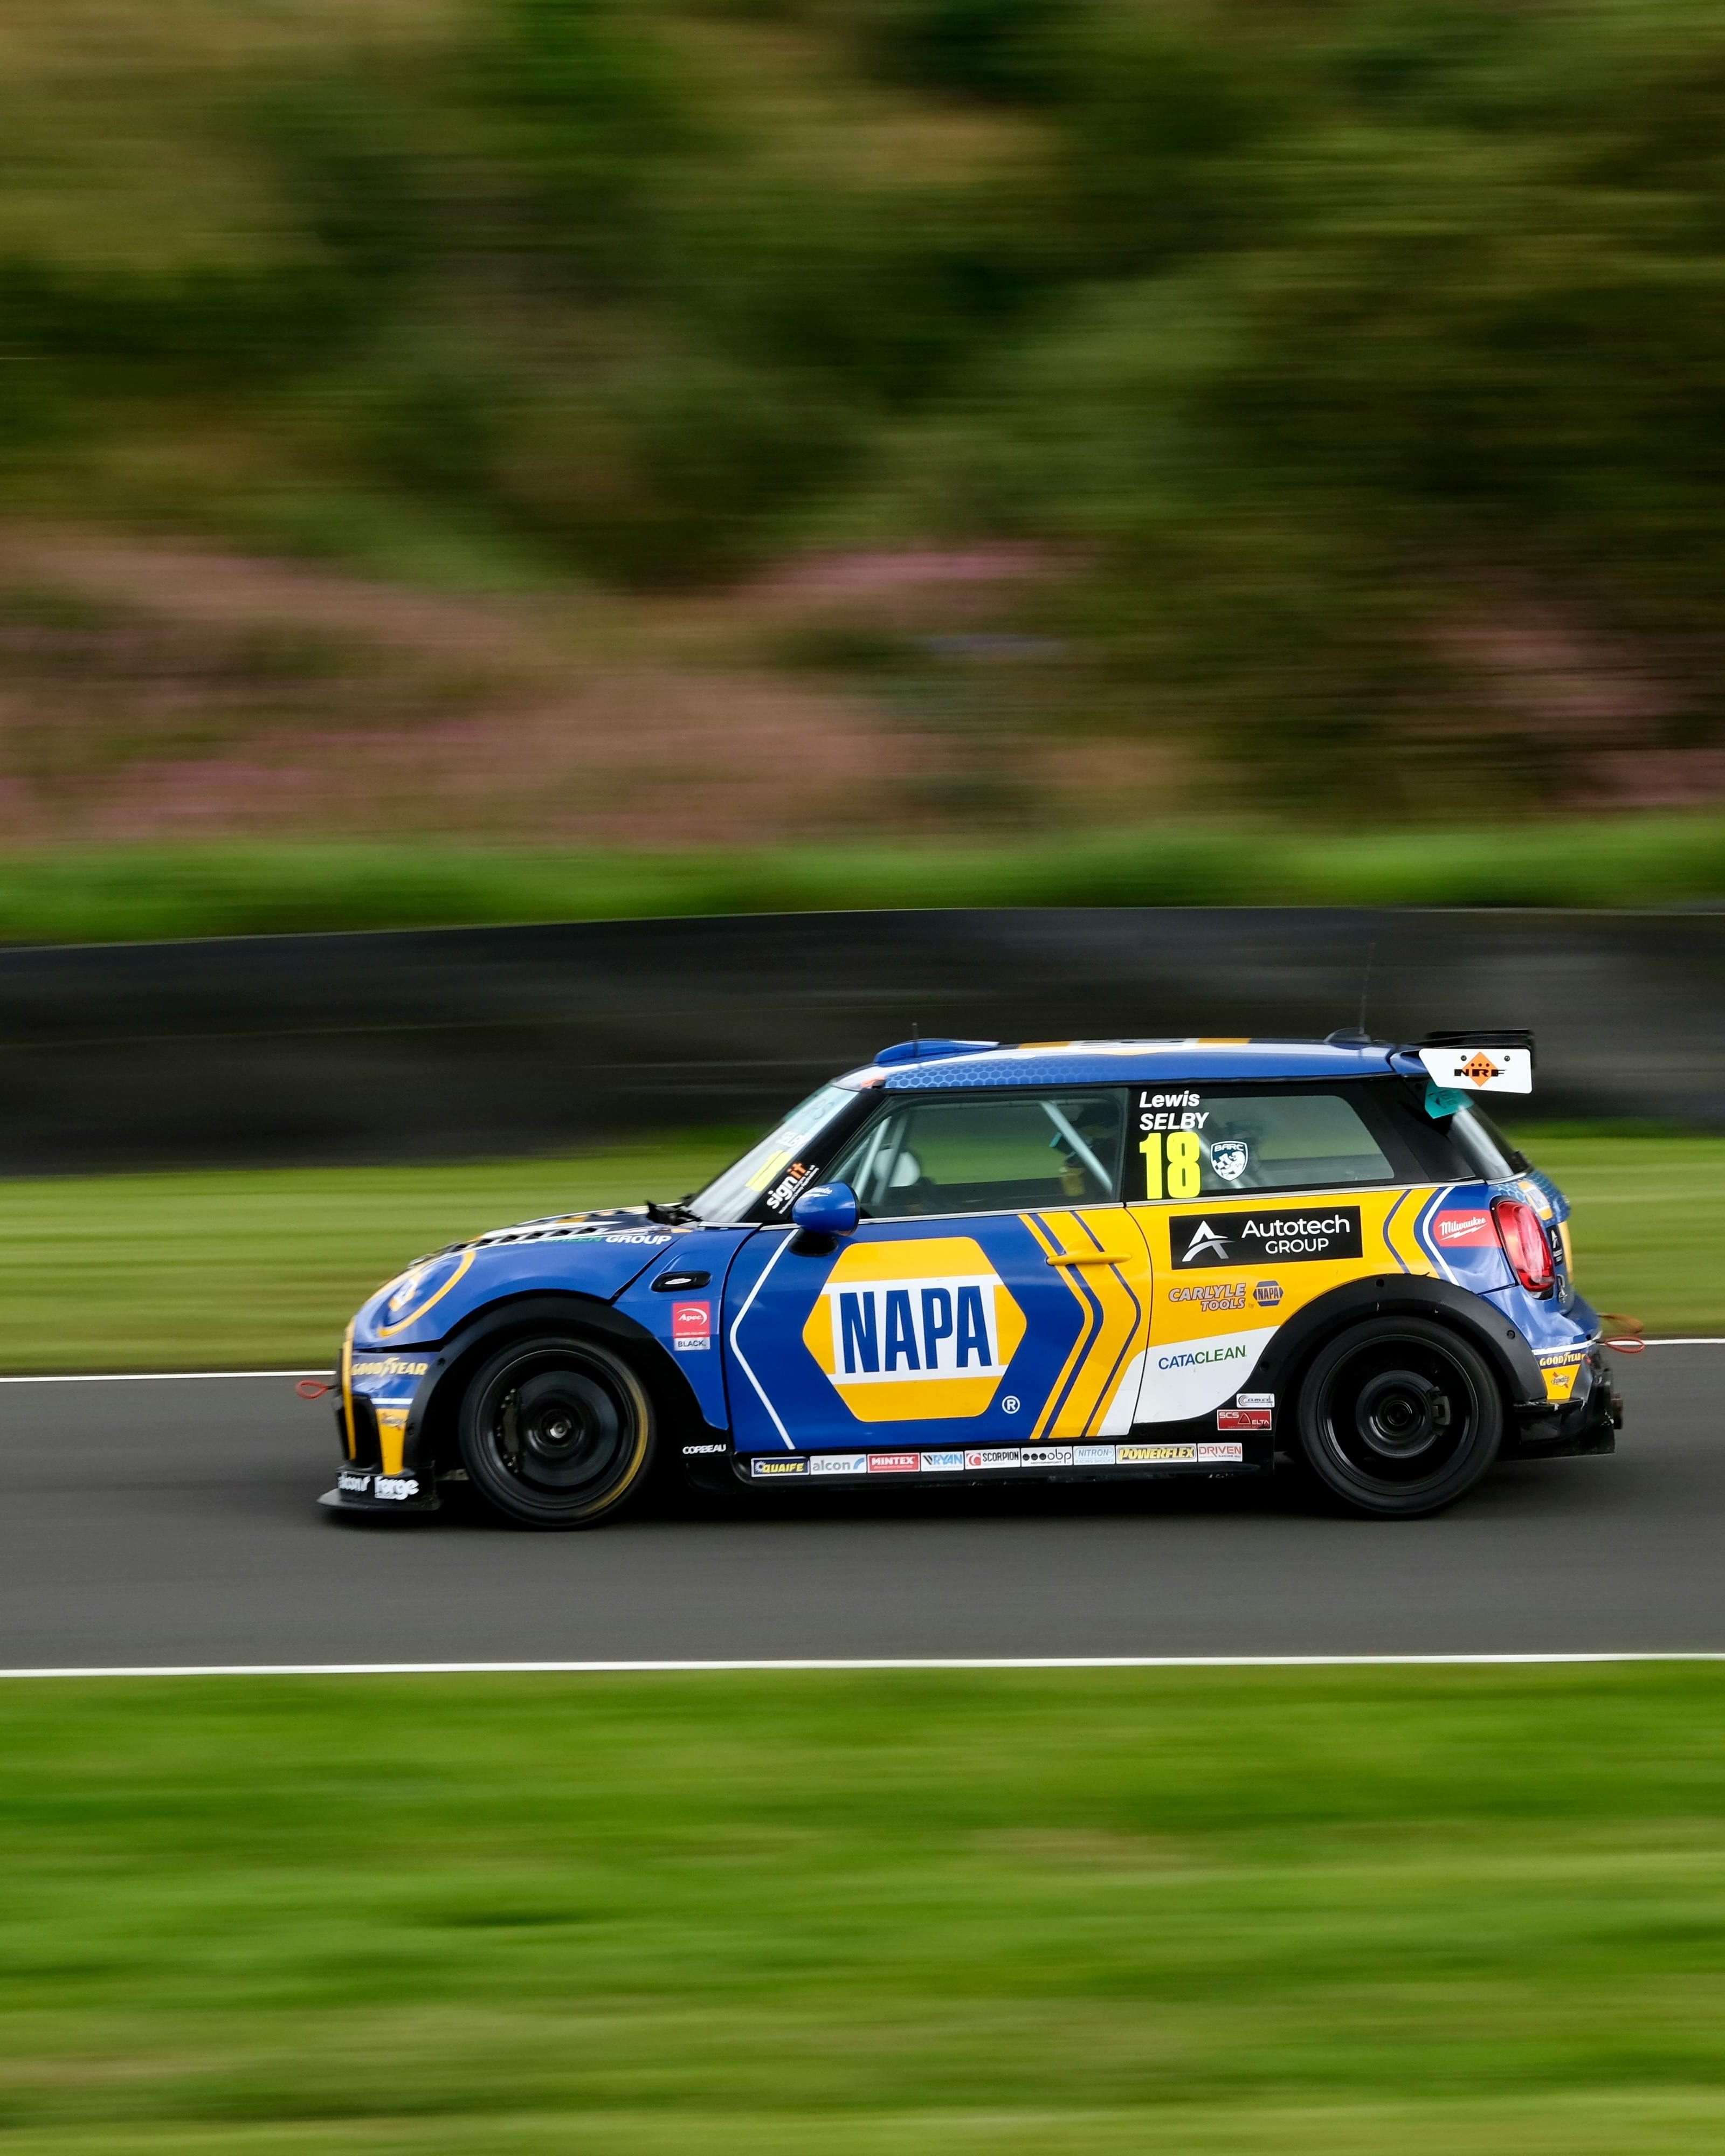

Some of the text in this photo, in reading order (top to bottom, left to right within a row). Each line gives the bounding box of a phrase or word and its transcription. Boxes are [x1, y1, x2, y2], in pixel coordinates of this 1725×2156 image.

[1454, 1069, 1507, 1077] NRF
[1139, 1090, 1200, 1108] Lewis
[1139, 1112, 1210, 1131] SELBY
[1215, 1144, 1244, 1152] BARC
[1139, 1131, 1200, 1199] 18
[1241, 1214, 1350, 1238] Autotech
[1438, 1217, 1487, 1236] Milwaukee
[605, 1235, 672, 1245] GROUP
[1265, 1238, 1329, 1254] GROUP
[1169, 1283, 1246, 1302] CARLYLE
[1258, 1287, 1279, 1300] NAPA
[1200, 1298, 1246, 1312] TOOLS
[678, 1314, 703, 1322] Apec
[840, 1286, 992, 1374] NAPA
[1158, 1345, 1246, 1370] CATACLEAN
[682, 1444, 726, 1454] CORBEAU
[1119, 1447, 1194, 1461] POWERFLEX
[1199, 1446, 1241, 1457] DRIVEN
[871, 1456, 915, 1465] MINTEX
[983, 1452, 1019, 1462] SCORPION
[763, 1462, 804, 1473] QUAIFE
[812, 1460, 851, 1471] alcon
